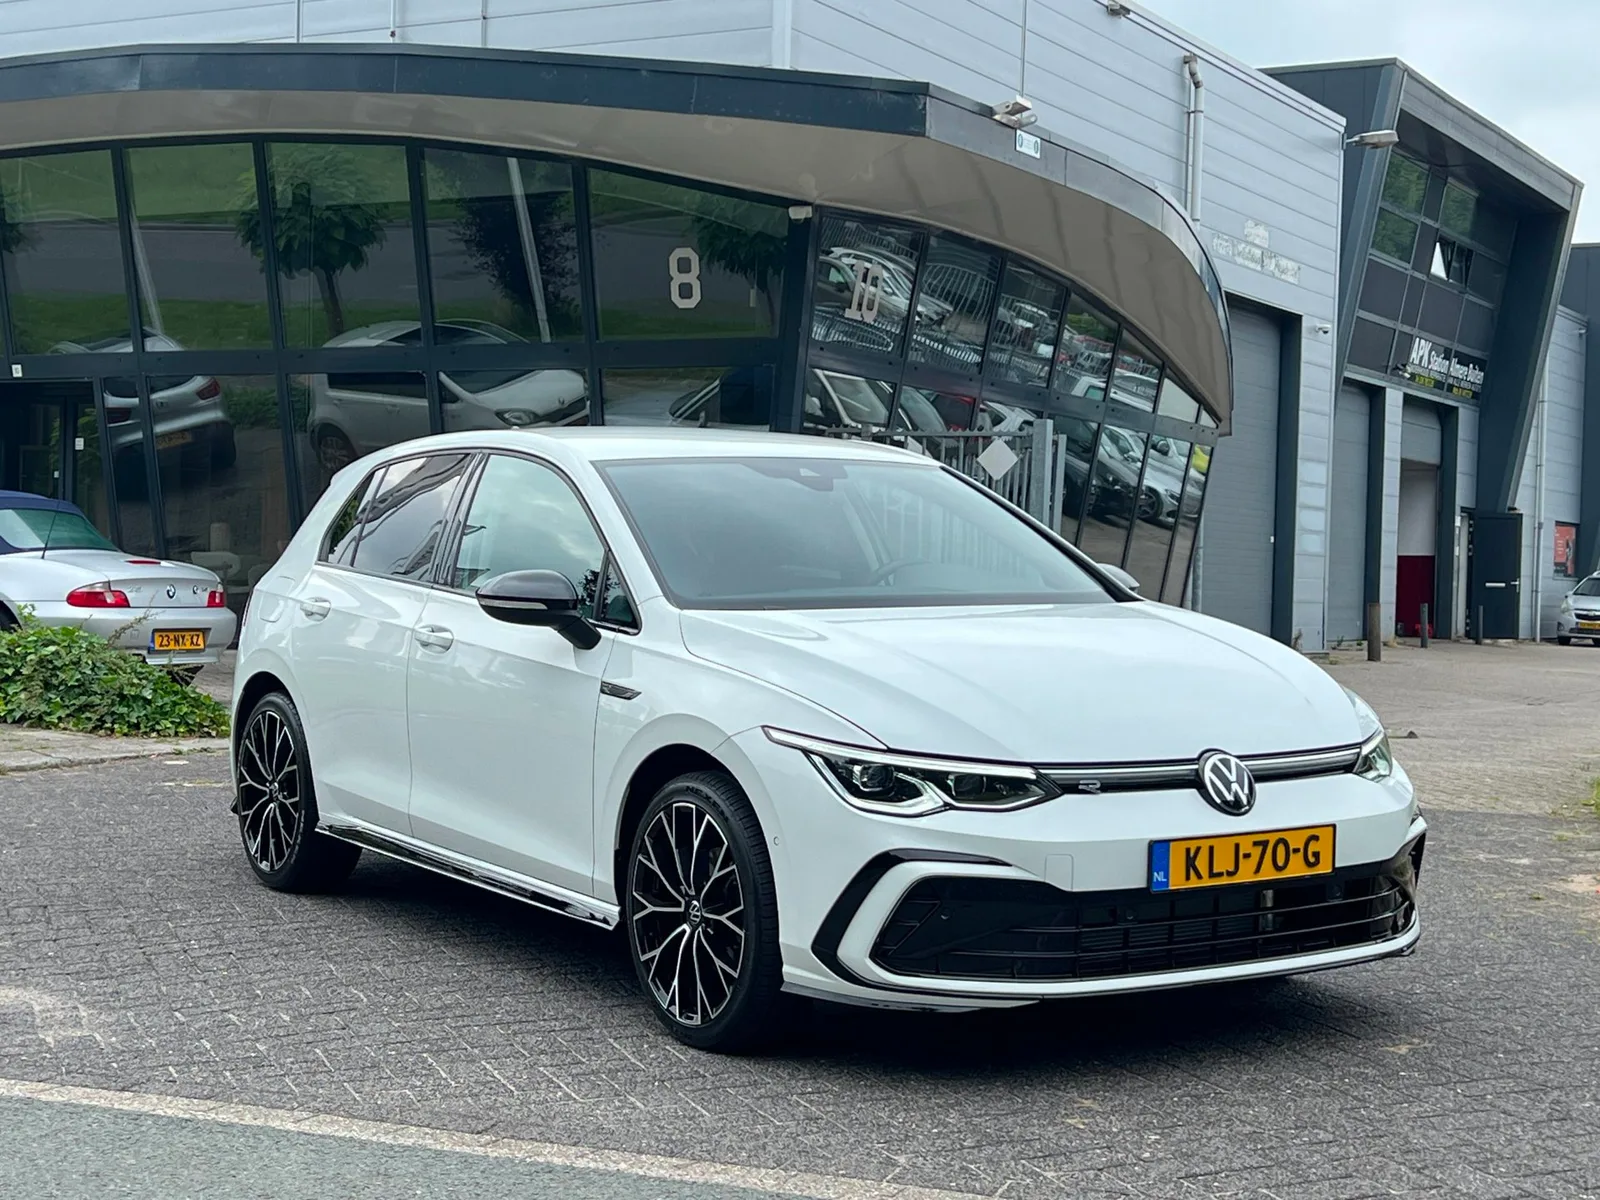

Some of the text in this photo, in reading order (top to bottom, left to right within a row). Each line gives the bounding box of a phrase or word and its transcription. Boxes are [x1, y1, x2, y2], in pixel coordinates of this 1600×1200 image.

[668, 247, 702, 309] 8
[844, 260, 883, 324] 10
[1409, 337, 1432, 368] APK
[1428, 350, 1450, 375] Station
[1449, 357, 1469, 381] Almere
[1467, 363, 1485, 385] Buiten
[1153, 834, 1321, 882] NL KLJ-70-G
